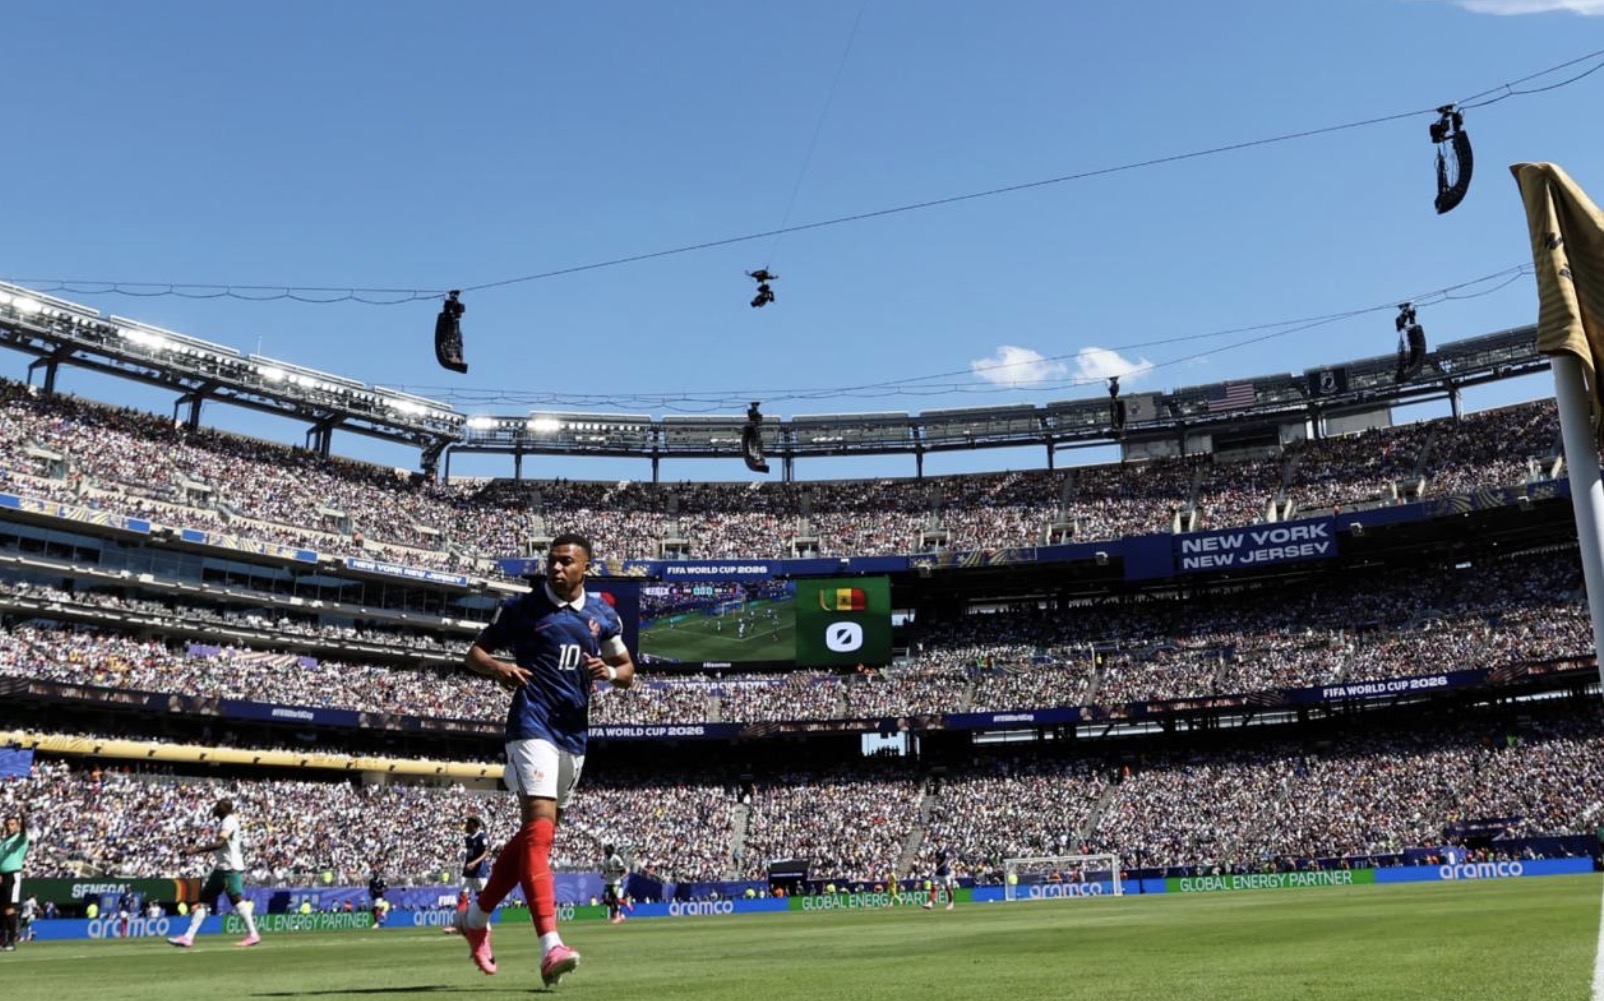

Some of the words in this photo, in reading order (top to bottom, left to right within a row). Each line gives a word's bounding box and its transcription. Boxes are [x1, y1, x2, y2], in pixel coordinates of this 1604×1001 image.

[1182, 534, 1244, 553] NEW
[1251, 523, 1329, 545] YORK
[1183, 553, 1234, 569] NEW
[1240, 541, 1331, 563] JERSEY
[353, 560, 375, 570] NEW
[377, 564, 403, 575] YORK
[404, 568, 425, 578] NEW
[667, 566, 686, 574] FIFA
[687, 566, 718, 574] WORLD
[719, 566, 737, 574] CUP
[737, 565, 768, 574] 2026
[558, 644, 581, 671] 10
[1323, 688, 1346, 699] FIFA
[1347, 684, 1386, 696] WORLD
[1387, 681, 1409, 692] CUP
[1410, 676, 1448, 689] 2026
[588, 727, 604, 737] IFA
[605, 726, 644, 737] WORLD
[646, 726, 667, 737] CUP
[668, 726, 704, 736] 2026
[1439, 861, 1523, 880] aramco
[71, 883, 131, 899] SENEGA
[1029, 882, 1102, 899] aramco
[1179, 876, 1231, 893] GLOBAL
[1233, 873, 1286, 890] ENERGY
[1288, 870, 1352, 886] PARTNER
[669, 898, 734, 916] aramco
[802, 895, 848, 911] GLOBAL
[849, 892, 892, 909] ENERG
[898, 890, 950, 906] PARTE
[226, 914, 273, 934] GLAL
[274, 913, 320, 931] ENERGY
[321, 911, 370, 929] PARTNER
[413, 910, 458, 926] aramc
